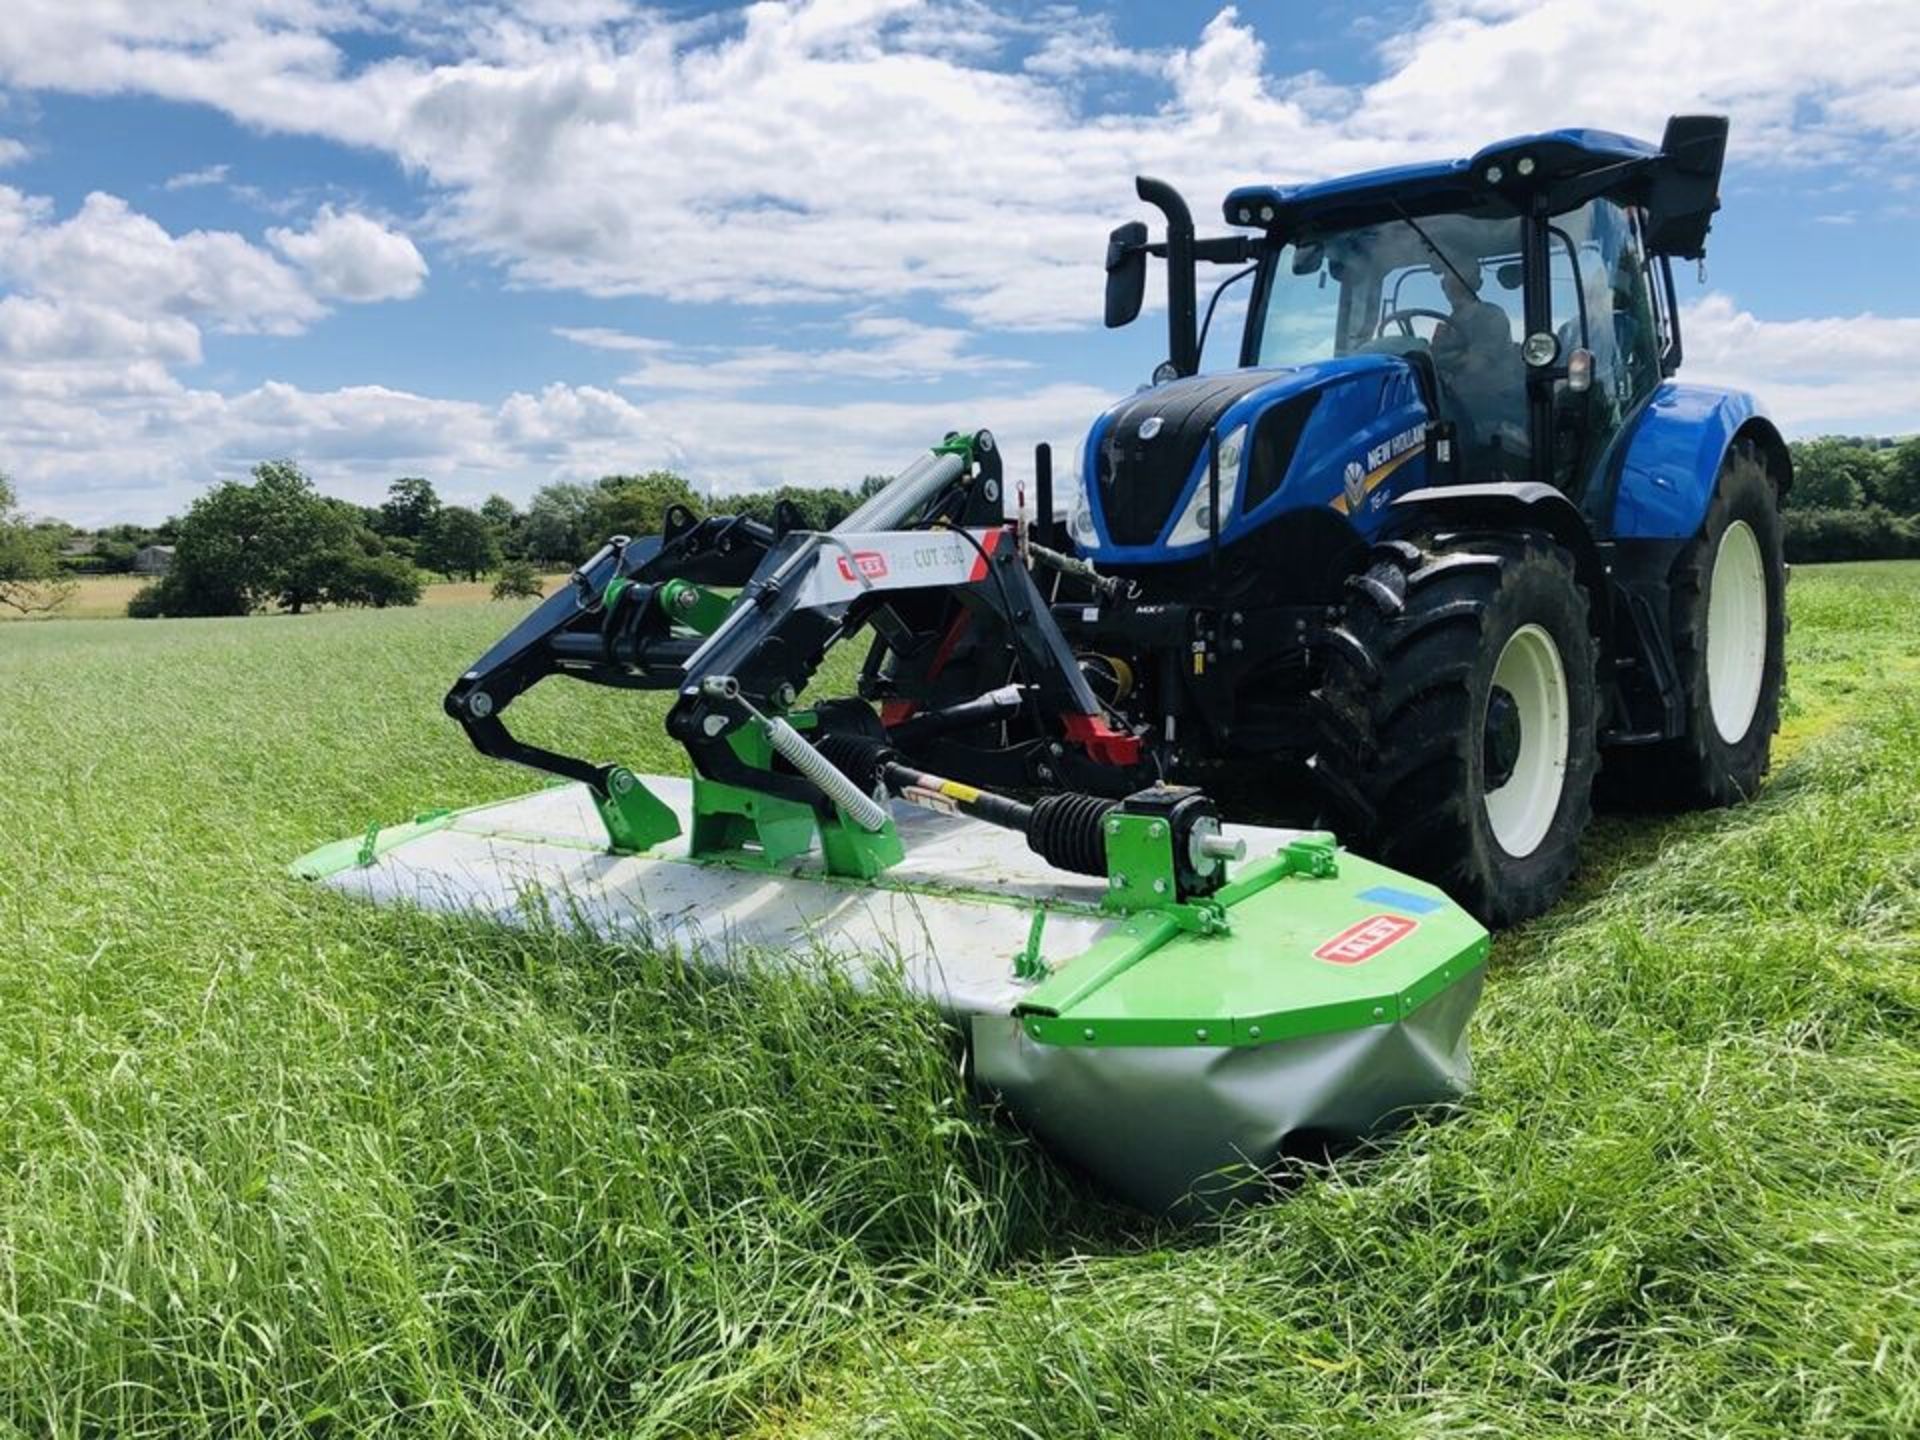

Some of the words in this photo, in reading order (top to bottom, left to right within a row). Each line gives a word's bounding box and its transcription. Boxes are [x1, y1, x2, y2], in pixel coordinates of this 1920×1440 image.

[1367, 440, 1391, 471] NEW
[1392, 421, 1427, 456] HOLLAN
[1322, 917, 1409, 959] TALEX
